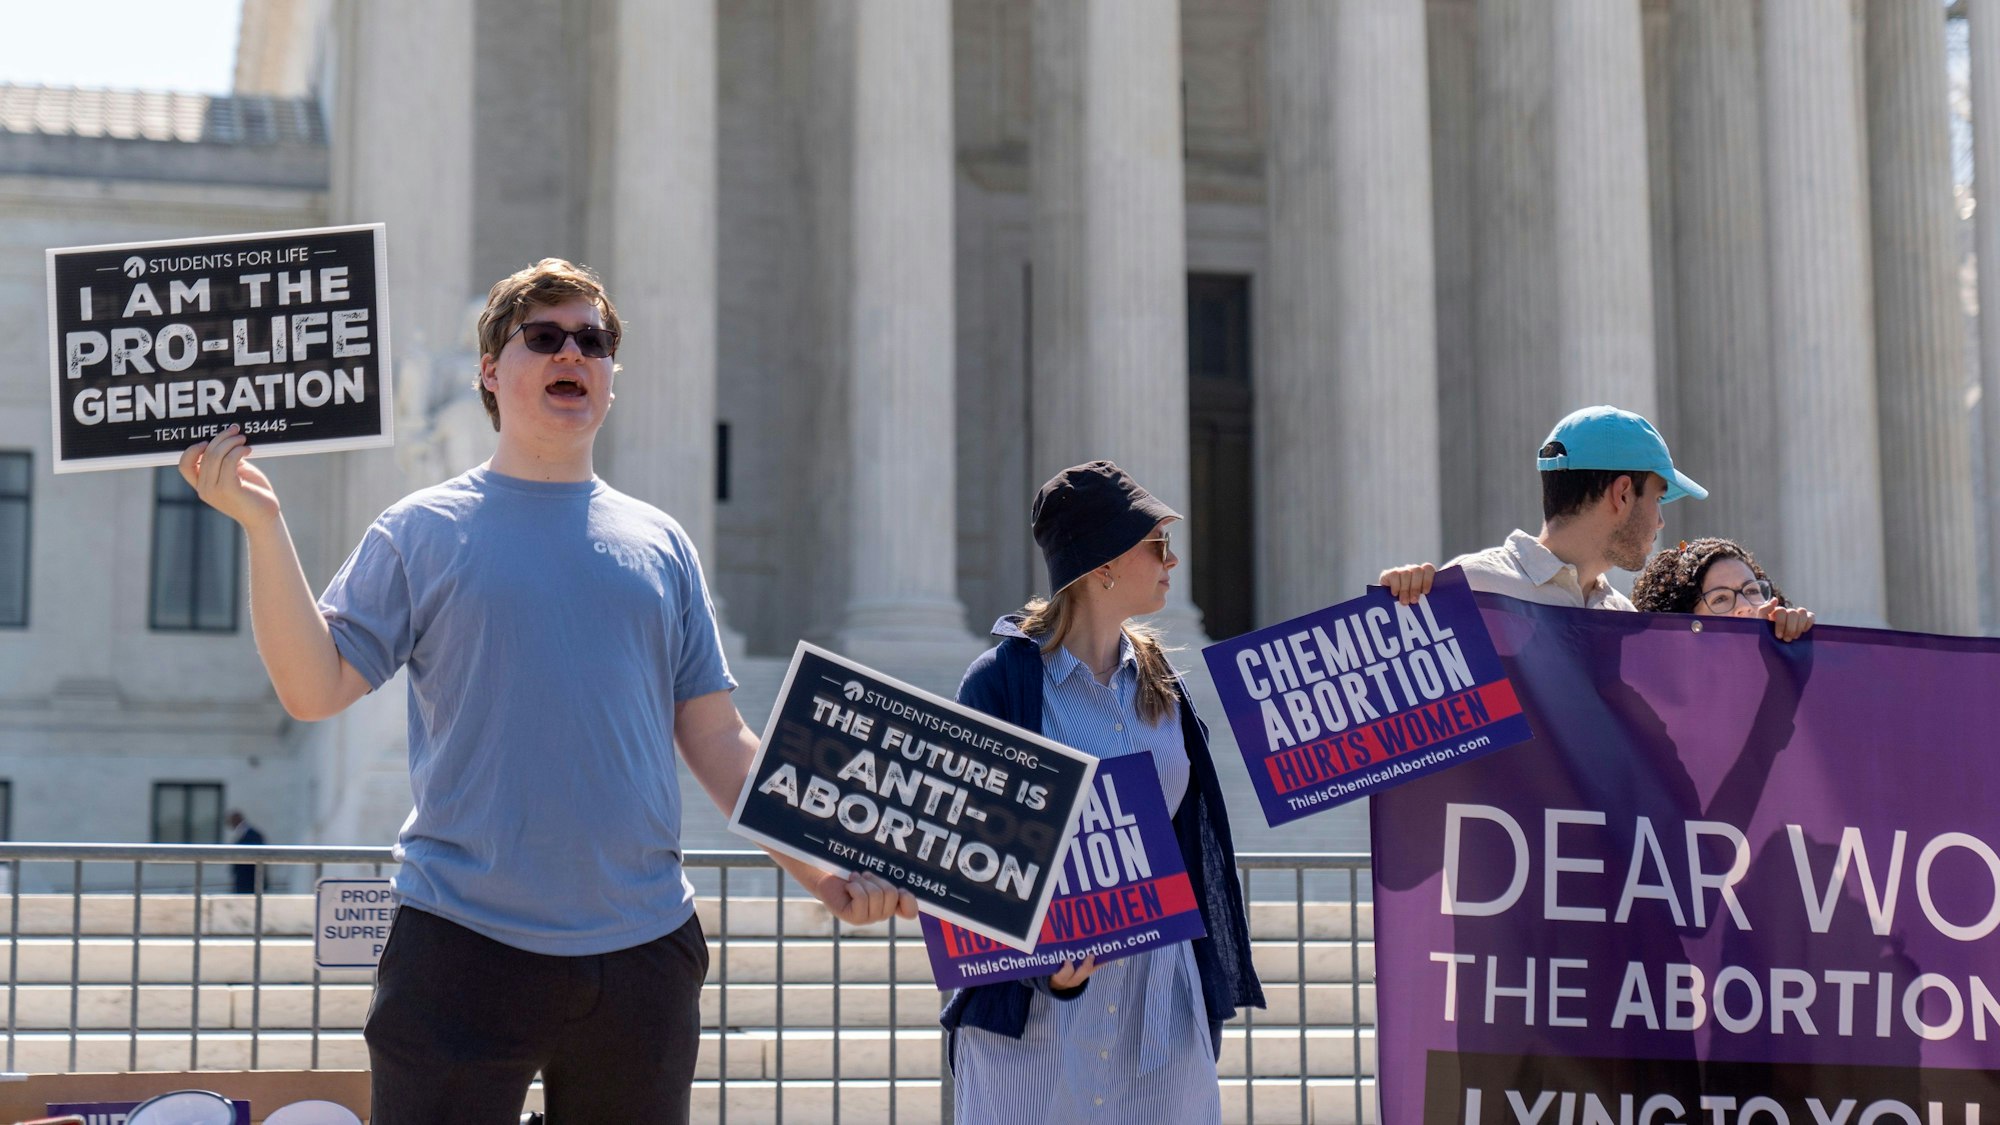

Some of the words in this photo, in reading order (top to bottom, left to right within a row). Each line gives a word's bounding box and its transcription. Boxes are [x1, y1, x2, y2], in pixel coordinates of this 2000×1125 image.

[79, 286, 93, 321] I
[122, 278, 211, 318] AM
[239, 266, 350, 308] THE
[149, 253, 233, 274] STUDENTS
[237, 249, 272, 267] FOR
[277, 247, 309, 265] LIFE
[65, 308, 371, 380] PRO-LIFE
[73, 366, 365, 426] GENERATION
[154, 427, 186, 441] TEXT
[190, 424, 218, 439] LIFE
[244, 418, 287, 435] 53445
[1235, 593, 1455, 701] CHEMICAL
[864, 690, 1040, 770] STUDENTSFORLIFE.ORG
[1259, 638, 1476, 753] ABORTION
[812, 696, 874, 742] THE
[880, 725, 1009, 796] FUTURE
[1015, 780, 1049, 811] IS
[1274, 731, 1371, 791] HURTS
[1373, 690, 1491, 751] WOMEN
[1287, 734, 1491, 812] ThisIsChemicalAbortion.com
[837, 749, 988, 826] ANTI-
[758, 763, 1040, 901] ABORTION
[827, 839, 858, 861] TEXT
[858, 850, 886, 873] LIFE
[888, 862, 905, 880] TO
[907, 873, 948, 898] 53445
[1440, 802, 1753, 932] DEAR
[324, 925, 391, 939] SUPRE
[341, 889, 395, 903] PROP
[1048, 882, 1164, 942] WOMEN
[958, 928, 1161, 979] ThisIsChemicalAbortion.com
[1429, 951, 1588, 1028] THE
[1610, 960, 2000, 1042] ABORTION
